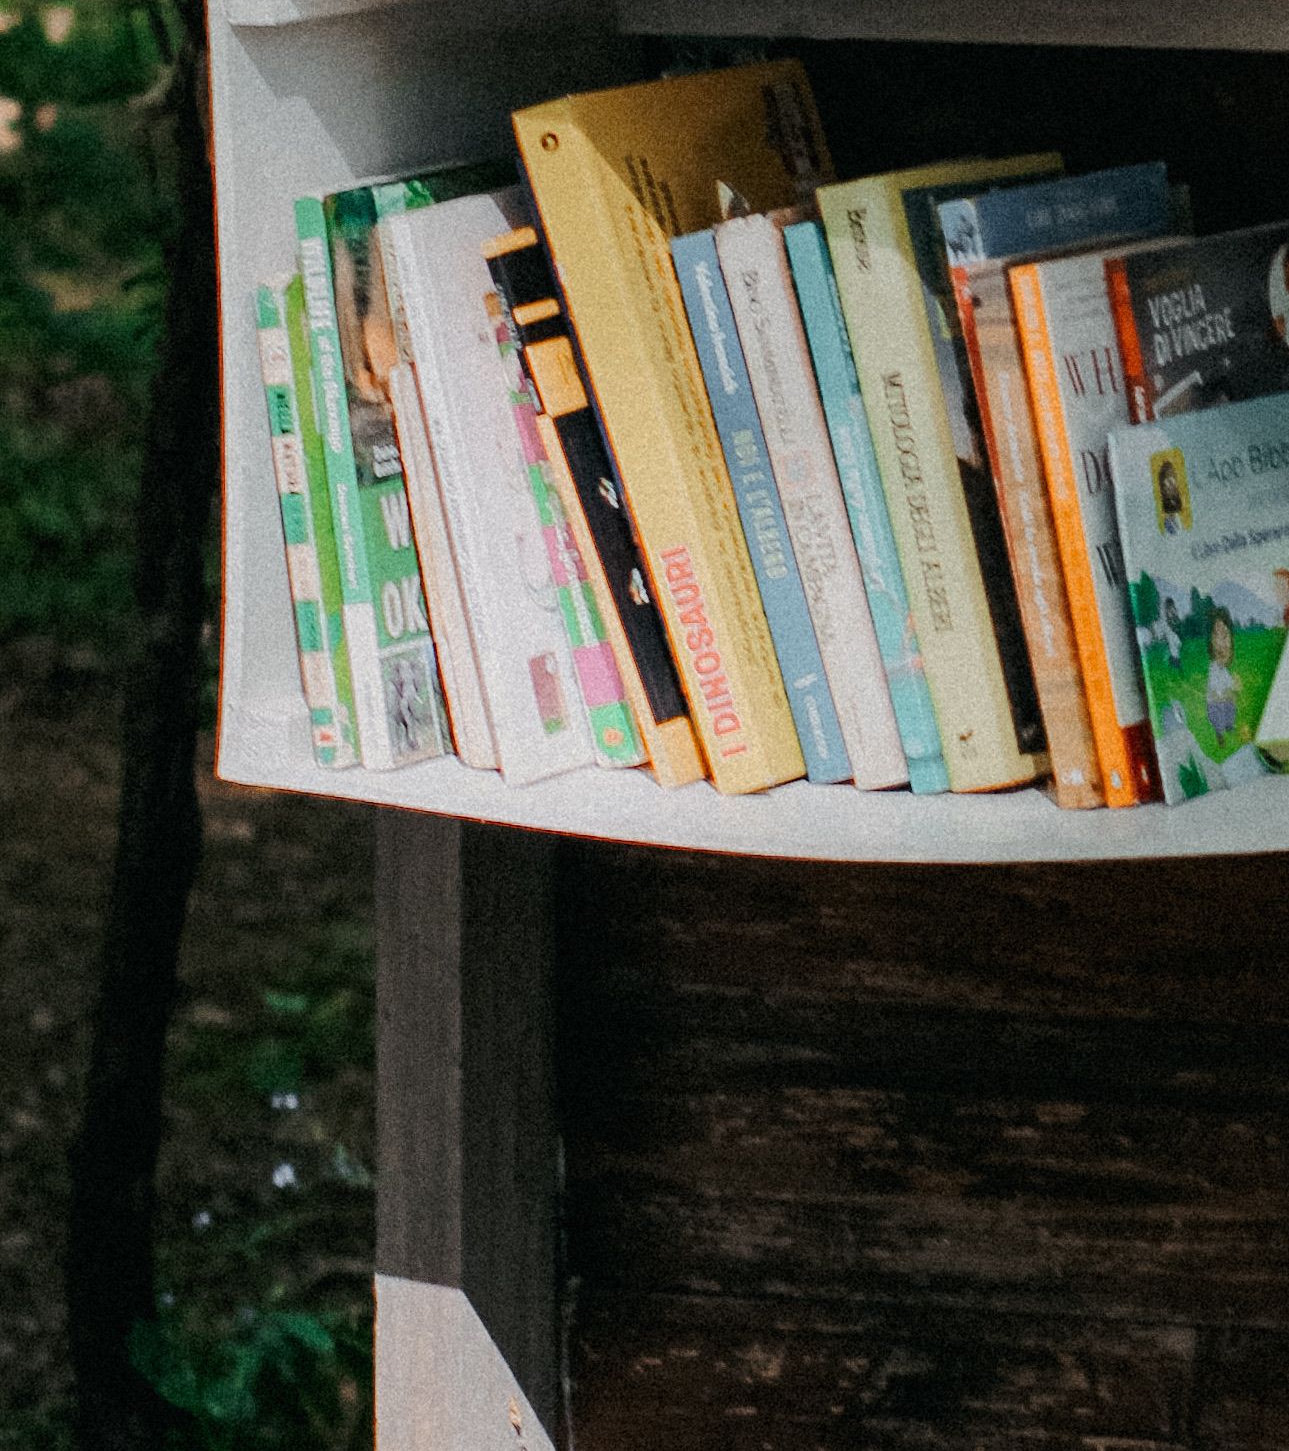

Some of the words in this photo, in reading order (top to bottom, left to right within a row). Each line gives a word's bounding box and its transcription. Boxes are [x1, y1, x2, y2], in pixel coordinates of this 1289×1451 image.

[1147, 284, 1207, 329] VOGLIA
[1153, 331, 1173, 367] DI
[729, 427, 761, 468] NOI
[874, 369, 929, 490] MITOLOGIA
[740, 469, 765, 486] E
[740, 486, 794, 582] L'ALBERO
[904, 490, 939, 555] DEGLI
[916, 555, 957, 635] ALBERI
[658, 541, 742, 739] DINOSAURI
[720, 744, 748, 758] I
